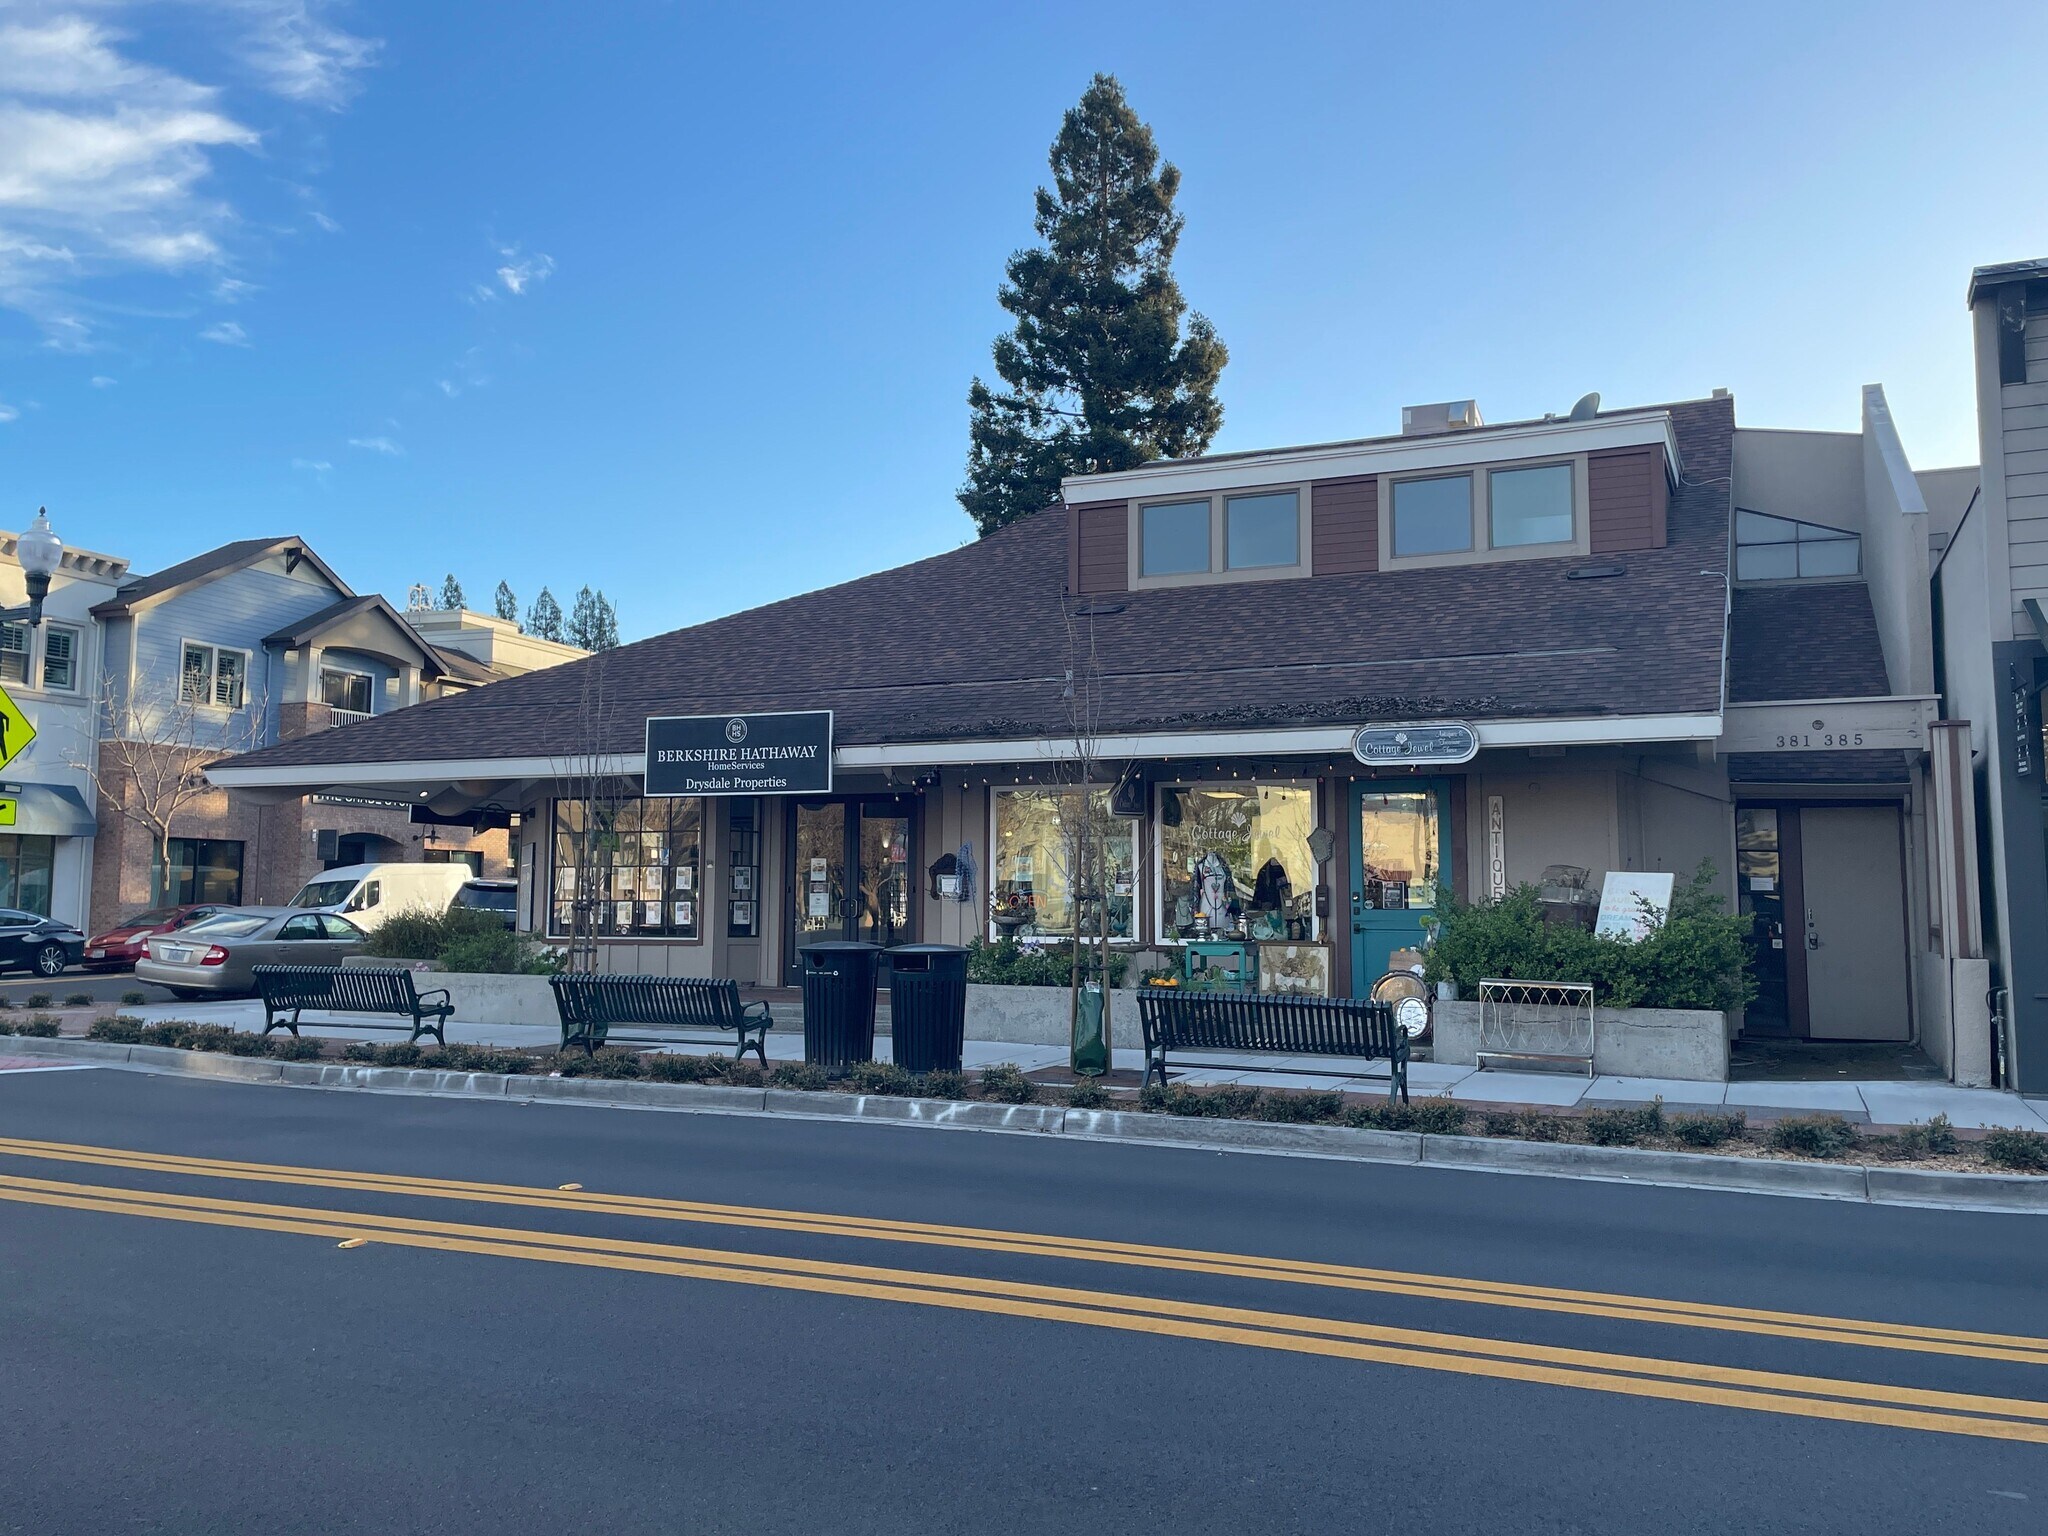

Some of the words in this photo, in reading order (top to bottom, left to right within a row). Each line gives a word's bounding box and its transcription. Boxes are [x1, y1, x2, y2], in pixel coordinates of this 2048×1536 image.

[1365, 742, 1401, 755] Cottage
[1404, 741, 1433, 755] Jewel
[1776, 735, 1810, 748] 381
[1824, 733, 1863, 746] 385
[657, 748, 737, 762] BERKSHIRE
[740, 745, 818, 760] HATHAWAY
[707, 760, 765, 770] HomeServices
[685, 777, 731, 791] Drysdale
[733, 775, 787, 790] Properties
[1191, 824, 1238, 842] Cottage
